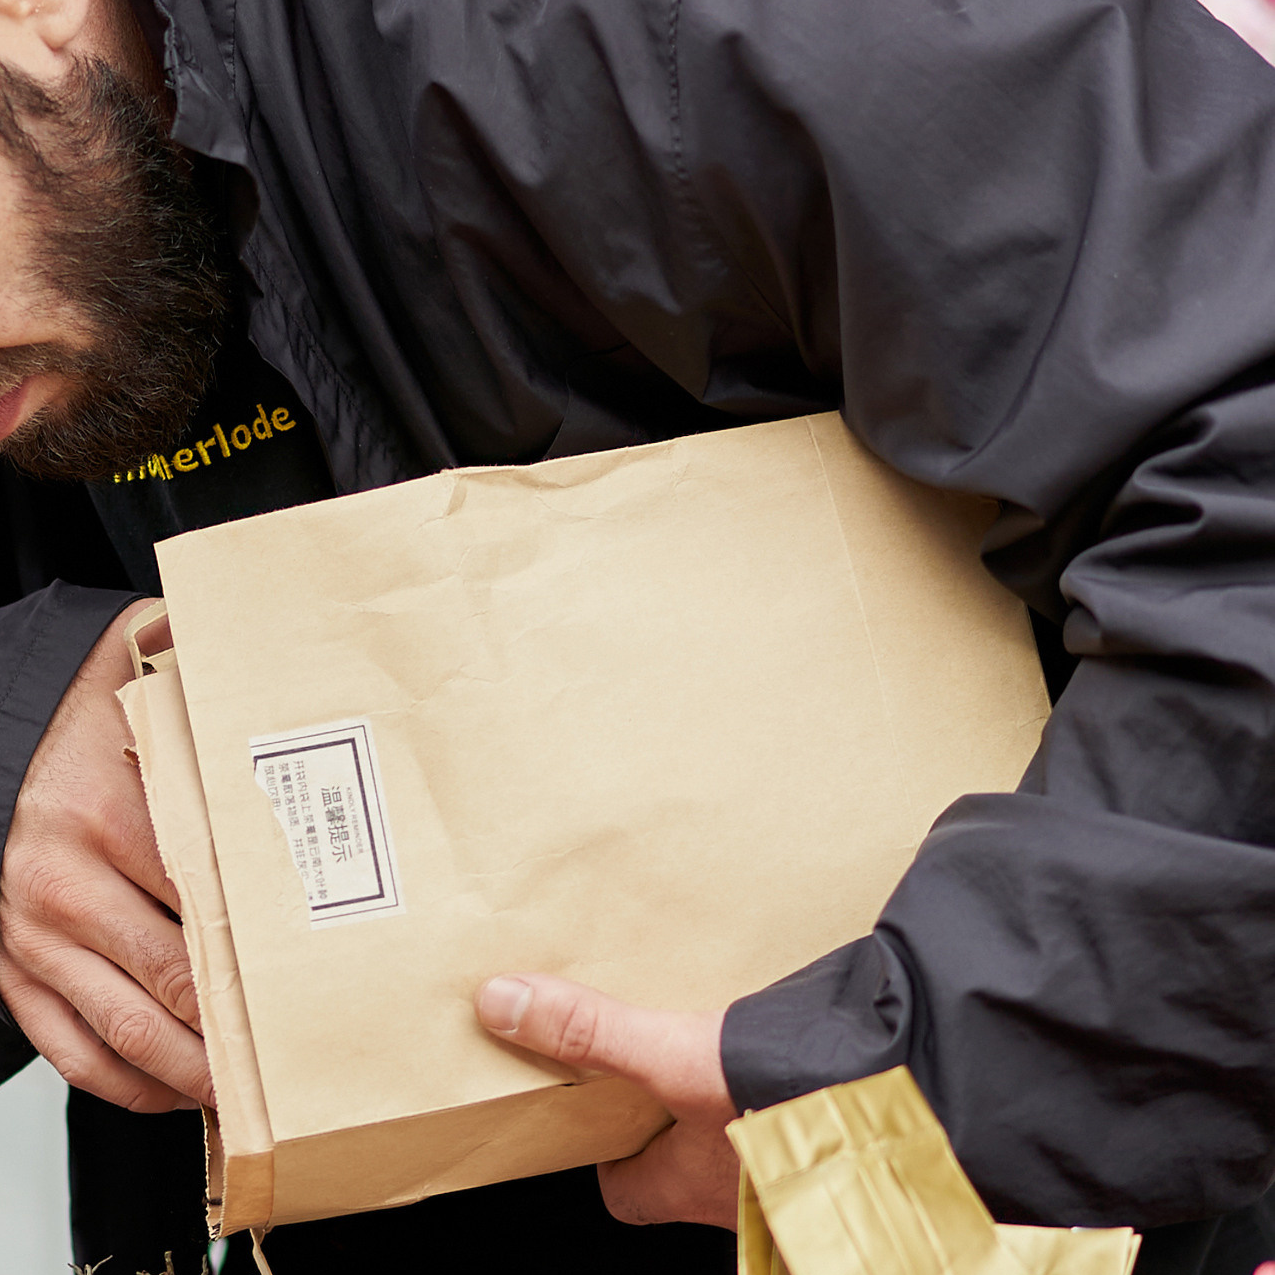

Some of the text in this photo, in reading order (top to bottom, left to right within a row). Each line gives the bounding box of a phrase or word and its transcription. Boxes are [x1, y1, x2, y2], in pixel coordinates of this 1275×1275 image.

[320, 785, 354, 863] 温馨提示
[351, 814, 364, 855] REMINDER
